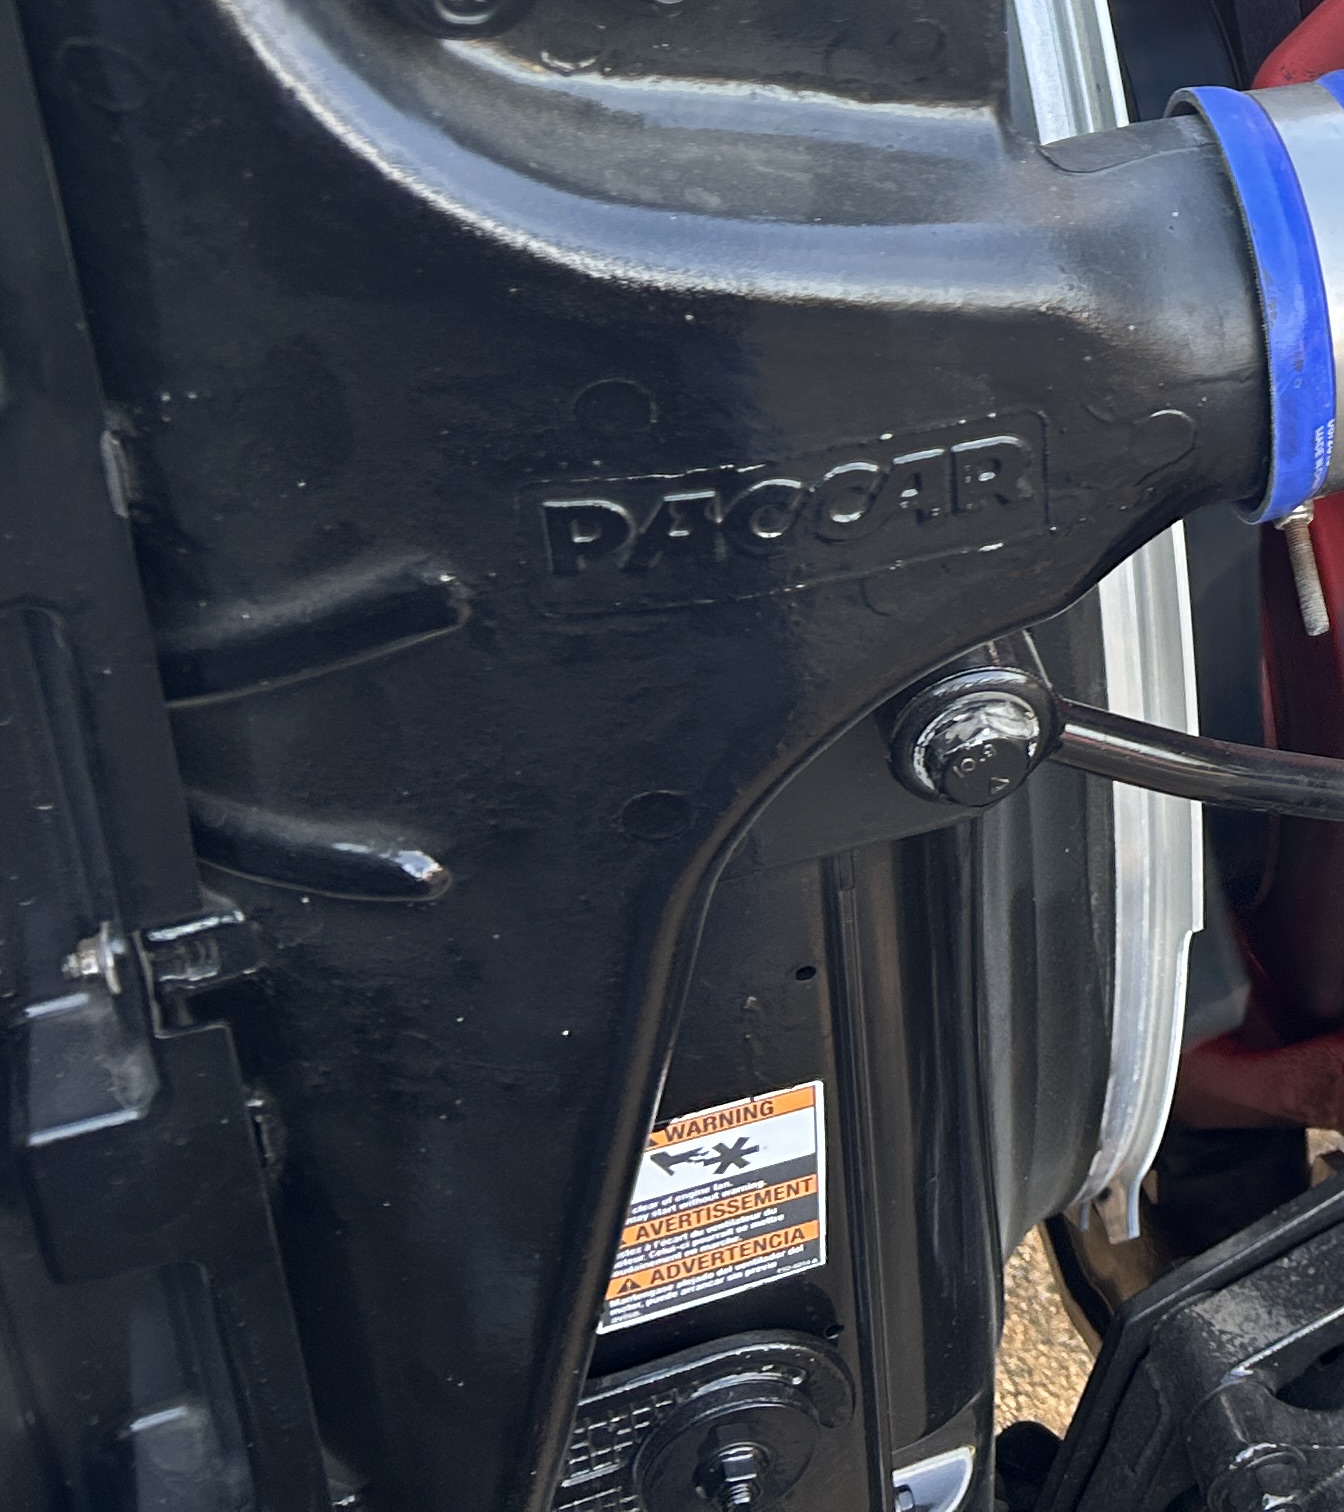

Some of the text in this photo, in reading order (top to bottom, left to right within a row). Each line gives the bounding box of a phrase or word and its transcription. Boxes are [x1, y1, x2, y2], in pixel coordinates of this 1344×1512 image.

[542, 435, 1035, 573] PACCAR
[663, 1100, 775, 1143] WARNING
[636, 1176, 814, 1242] AVERTISSEMENT
[652, 1204, 677, 1218] start
[679, 1194, 720, 1210] without
[721, 1178, 768, 1198] warning.
[661, 1195, 673, 1206] of
[674, 1187, 711, 1205] engine
[763, 1206, 778, 1218] du
[650, 1227, 806, 1285] ADVERTENCIA
[716, 1265, 733, 1278] del
[787, 1244, 804, 1256] del
